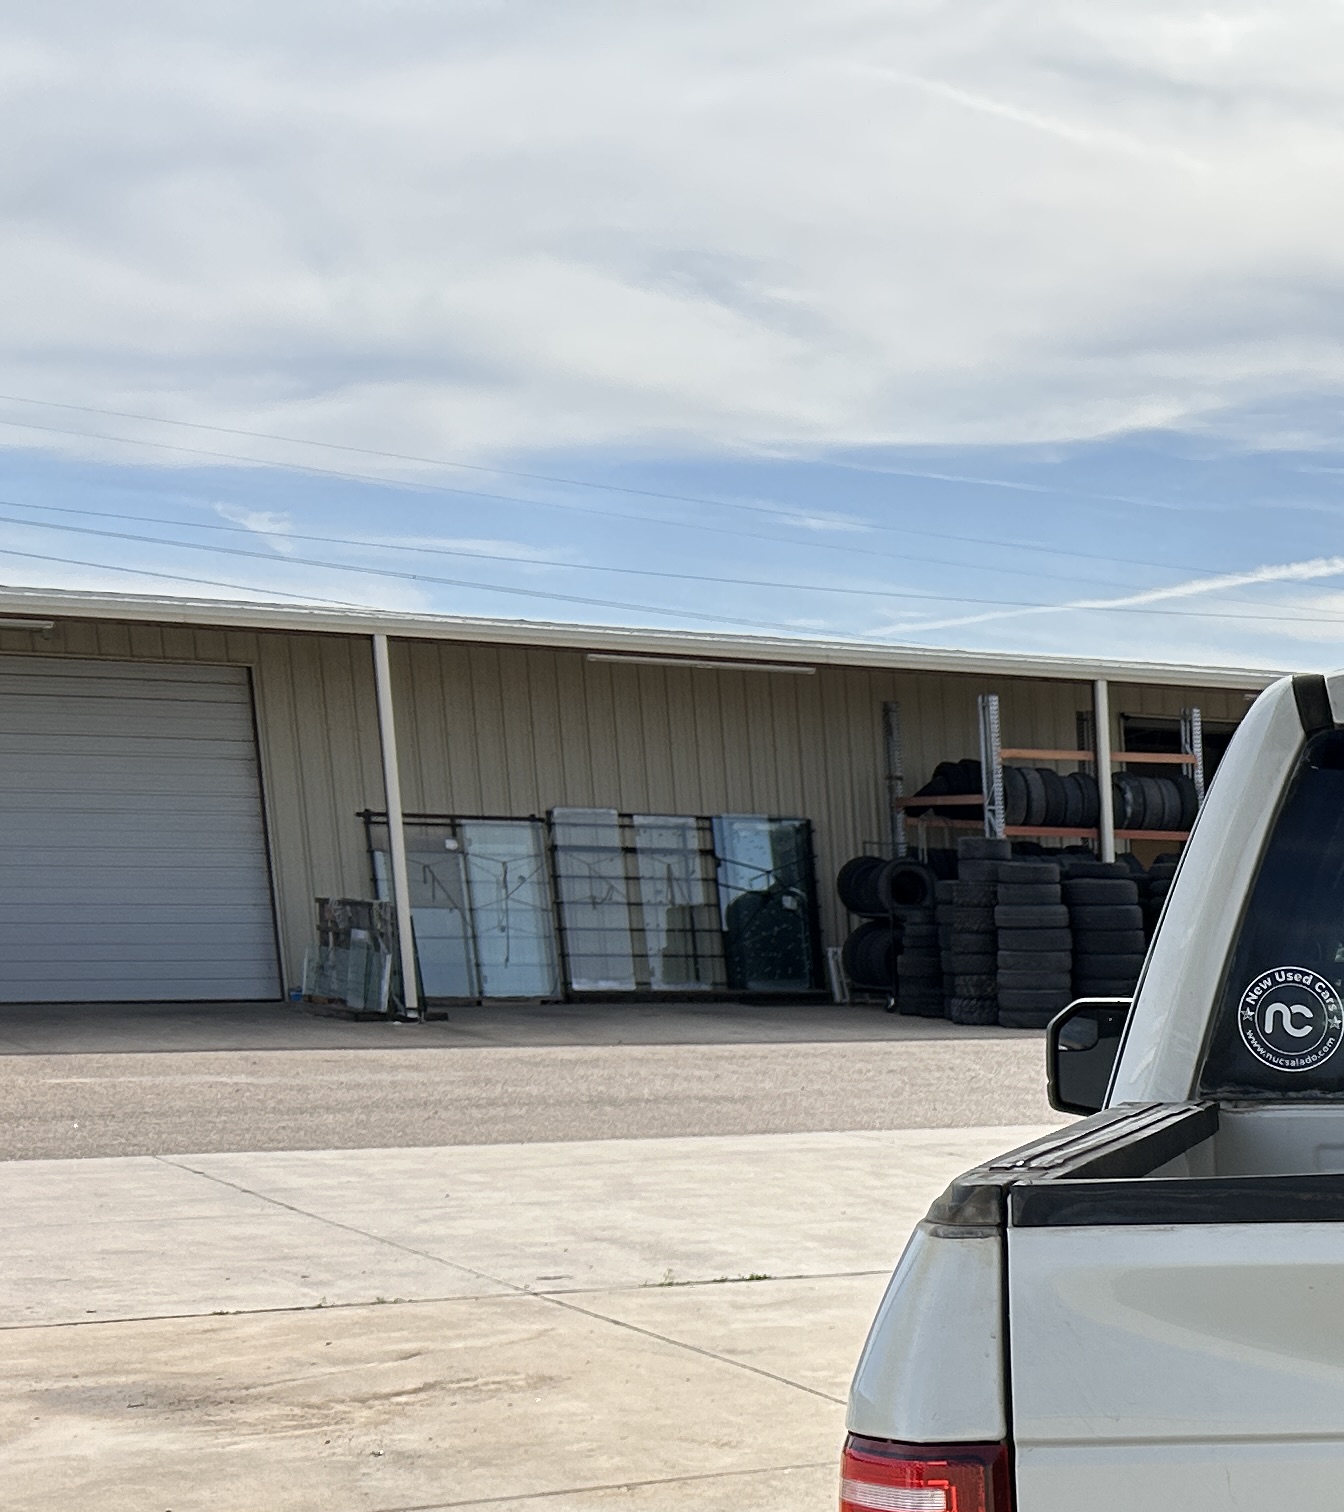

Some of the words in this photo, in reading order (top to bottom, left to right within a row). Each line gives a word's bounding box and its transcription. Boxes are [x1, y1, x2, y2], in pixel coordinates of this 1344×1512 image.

[1246, 978, 1272, 1005] New
[1275, 971, 1313, 985] Used
[1315, 982, 1337, 1012] Cars
